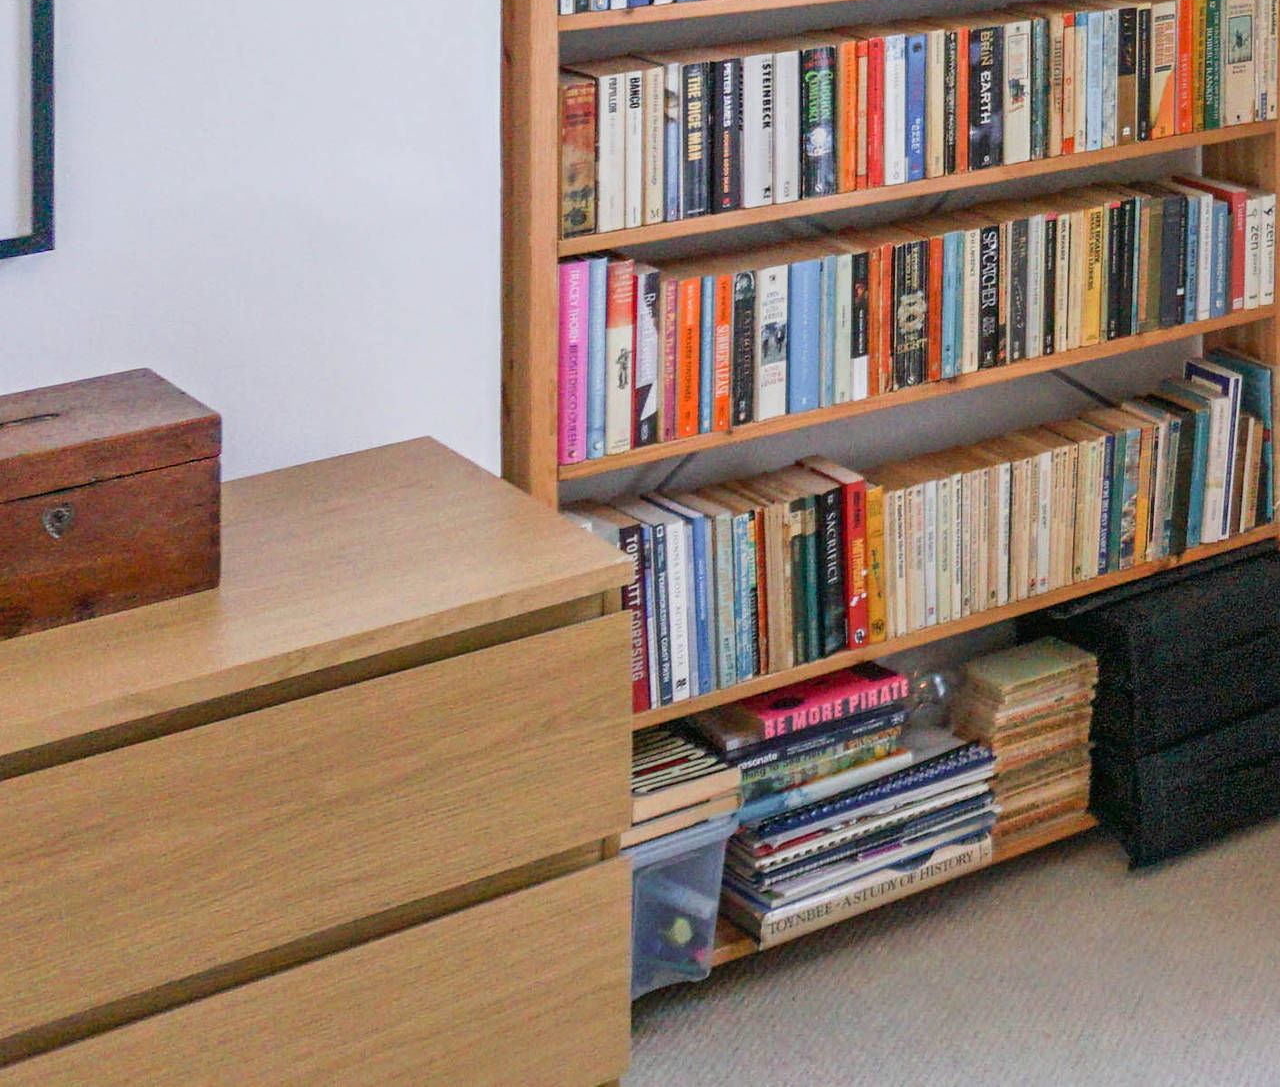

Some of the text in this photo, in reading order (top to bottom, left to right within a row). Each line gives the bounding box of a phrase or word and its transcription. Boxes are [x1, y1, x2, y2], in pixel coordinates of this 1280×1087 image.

[980, 31, 990, 66] BRIN
[629, 77, 640, 109] BANCO
[762, 63, 771, 129] STEINBECK
[980, 70, 991, 125] EARTH
[687, 76, 702, 161] THE DICE MAN
[1250, 225, 1260, 251] zen
[1266, 222, 1274, 249] zen
[568, 268, 580, 307] TRACEY
[981, 231, 997, 309] SPYCATCHER
[568, 309, 579, 343] THORN
[715, 368, 728, 397] LEASE
[764, 678, 909, 739] BE MORE PIRATE
[768, 902, 832, 935] TOYNBEE
[852, 878, 897, 905] STUDY
[899, 873, 917, 888] OF
[919, 850, 974, 882] HISTORY
